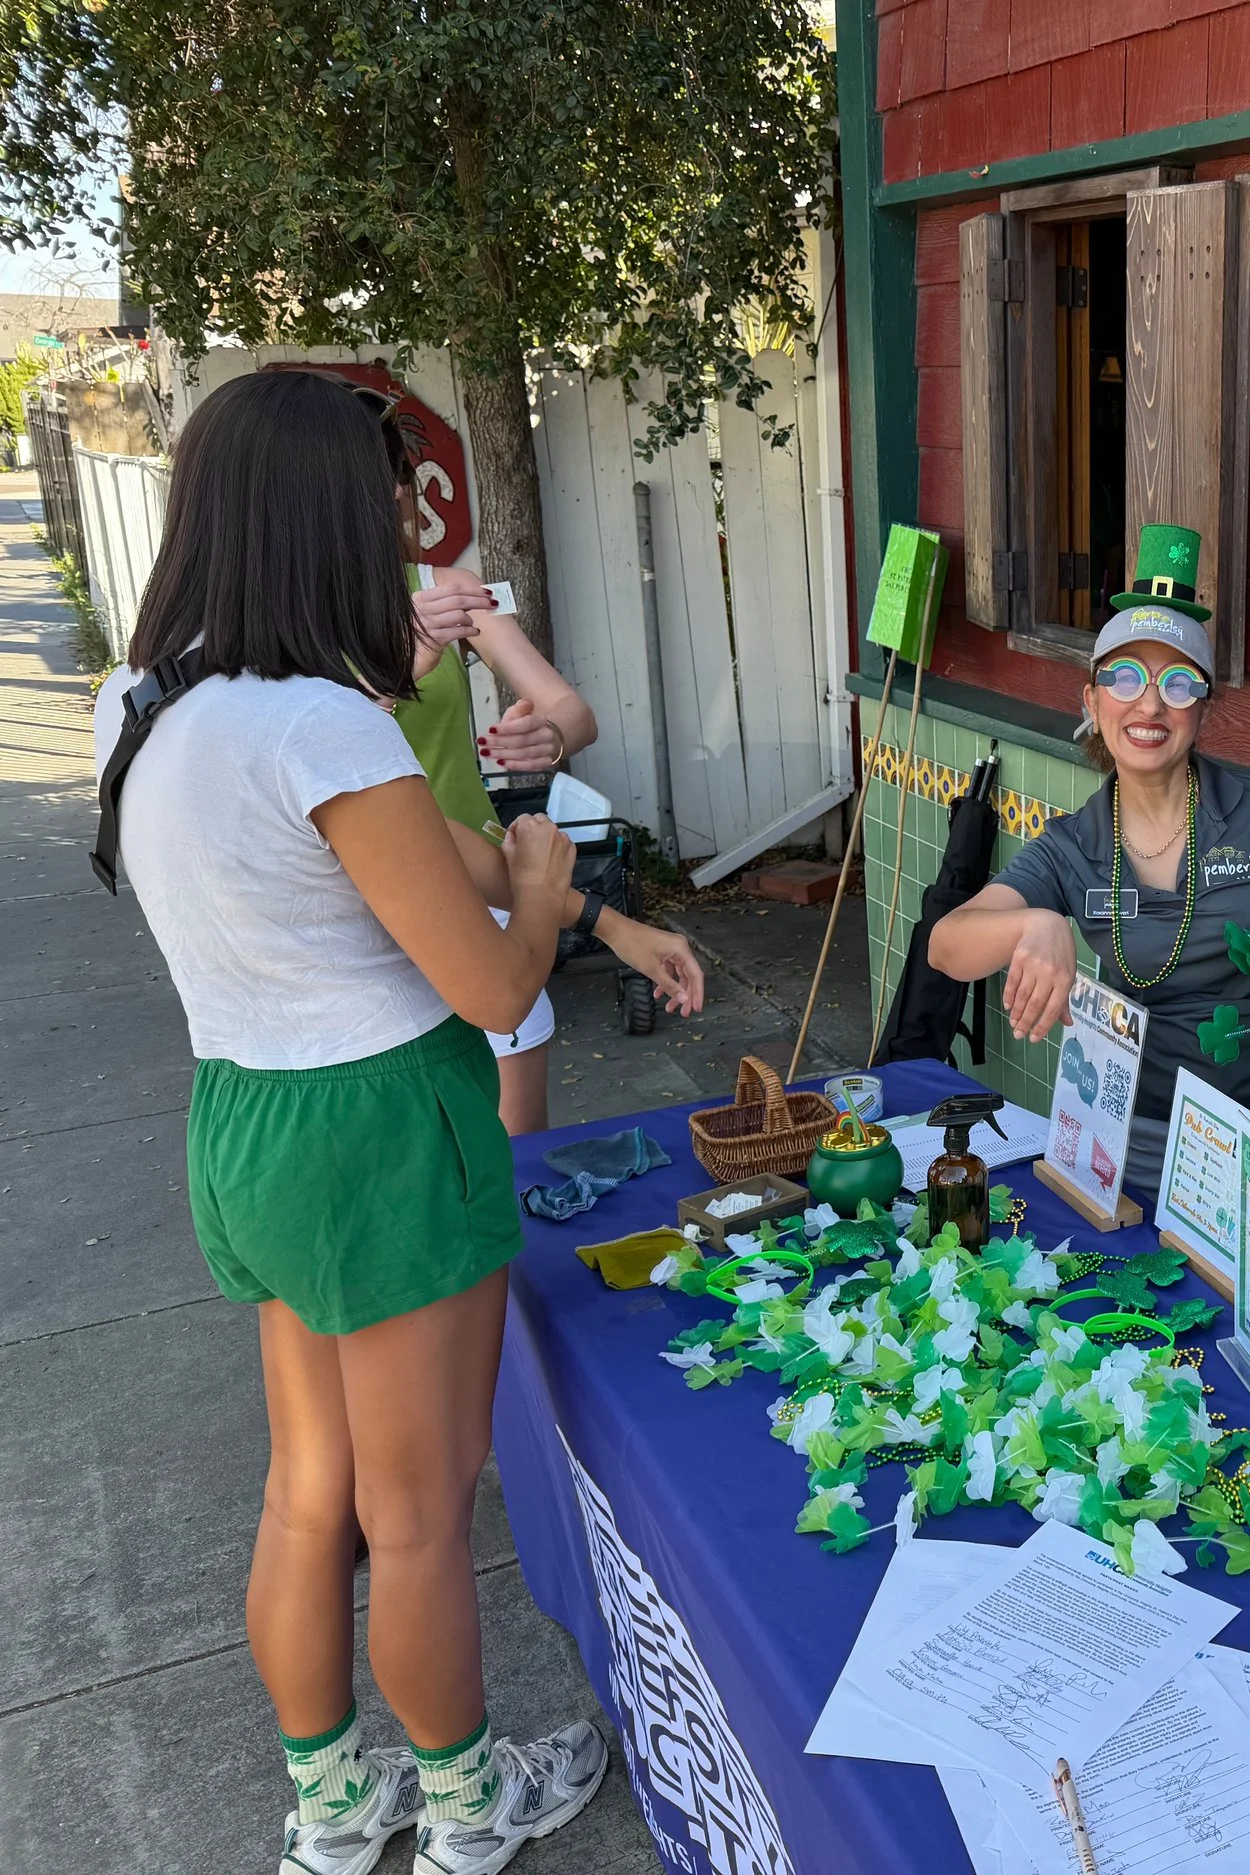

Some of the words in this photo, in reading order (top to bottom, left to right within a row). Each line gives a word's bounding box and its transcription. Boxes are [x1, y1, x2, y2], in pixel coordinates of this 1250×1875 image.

[1131, 617, 1183, 640] pemberley
[1062, 1050, 1079, 1072] JOIN
[1081, 1073, 1095, 1095] US!
[1184, 1110, 1203, 1135] Pub
[1204, 1124, 1232, 1156] Crawl
[392, 1784, 418, 1816] N
[522, 1781, 544, 1815] N
[1204, 1843, 1232, 1858] SIGNATURE
